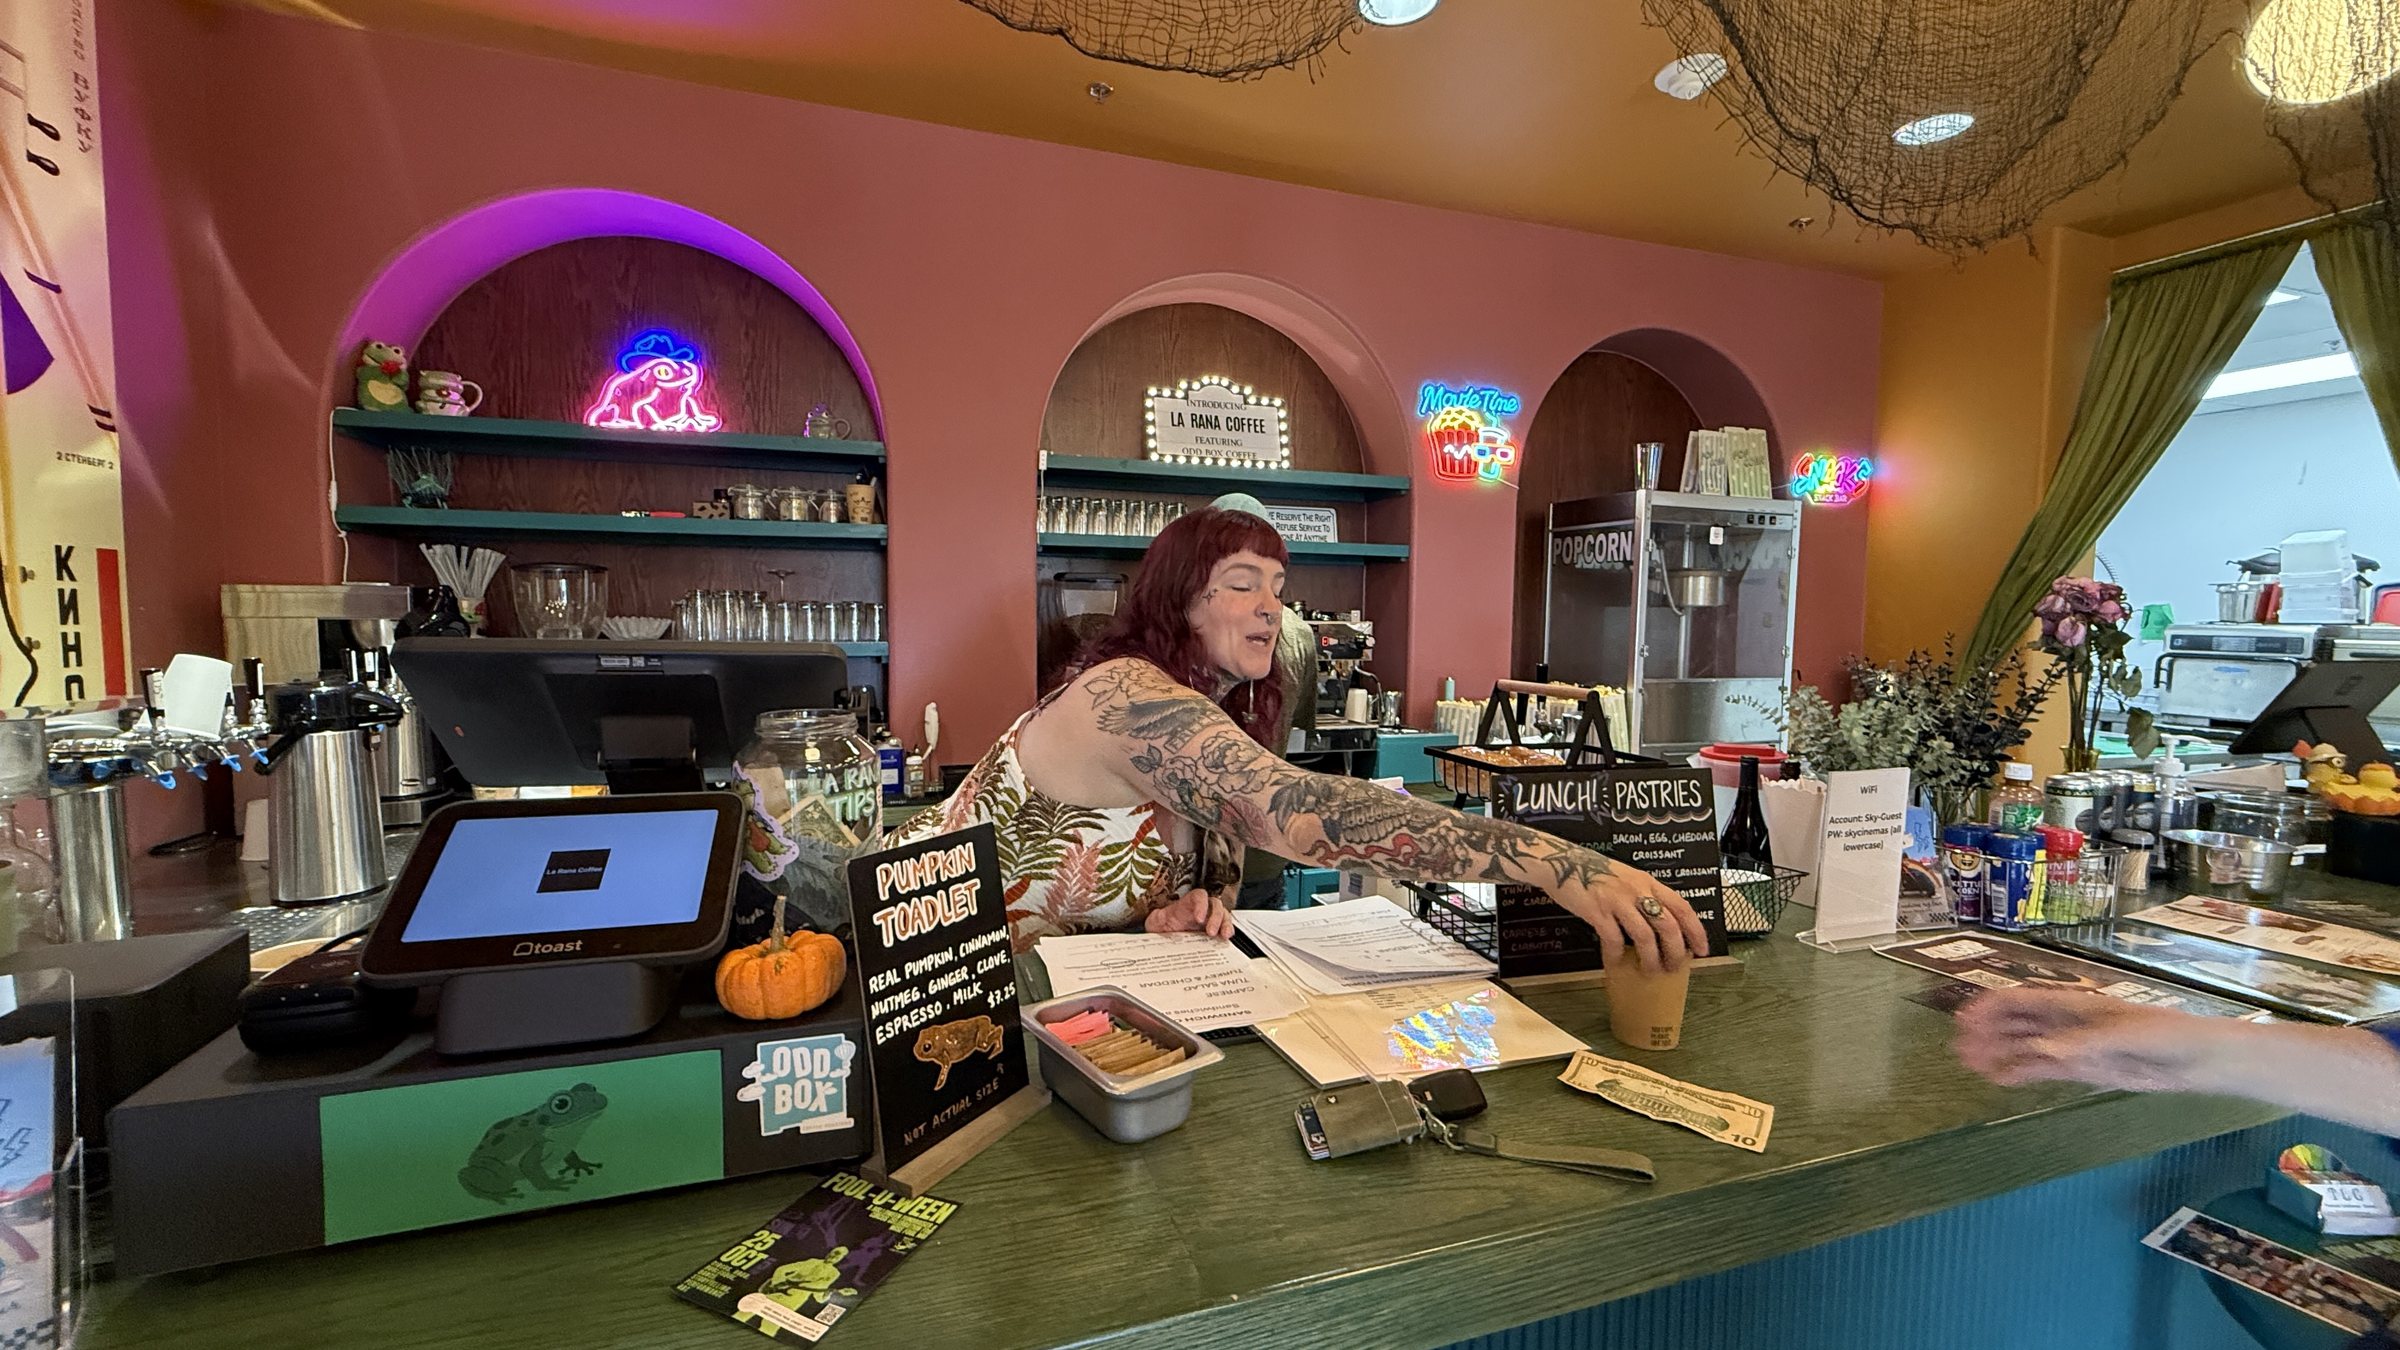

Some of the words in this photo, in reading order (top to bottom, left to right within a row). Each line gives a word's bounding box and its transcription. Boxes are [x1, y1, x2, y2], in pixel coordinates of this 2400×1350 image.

[1186, 399, 1248, 411] INTRODUCING
[1420, 385, 1481, 415] Movie
[1480, 389, 1519, 413] Time
[1170, 411, 1186, 428] LA
[1190, 412, 1221, 431] RANA
[1225, 416, 1266, 434] COFFEE
[1195, 435, 1243, 447] FEATURING
[1181, 446, 1203, 456] ODD
[1205, 448, 1223, 458] BOX
[1225, 449, 1257, 460] COFFEE
[1552, 531, 1633, 565] POPCORN
[844, 763, 880, 791] RAN
[1515, 778, 1599, 813] LUNCH!
[1615, 779, 1702, 811] PASTRIES
[1860, 785, 1878, 794] WiFi
[827, 787, 876, 822] TIPS
[1829, 815, 1863, 825] Account:
[1864, 812, 1903, 823] Sky-Guest
[1612, 833, 1648, 845] BACON,
[1672, 831, 1716, 843] CHEDDAR
[1827, 830, 1843, 839] PW:
[1844, 827, 1888, 838] skycinemas
[1843, 840, 1884, 852] lowercase)
[1632, 848, 1685, 861] CROISSANT
[557, 866, 577, 875] Rana
[577, 866, 603, 874] Coffee
[876, 842, 976, 901] PUMPKIN
[1675, 867, 1719, 877] CROISSANT
[1675, 887, 1717, 898] OISSANT
[1957, 886, 1980, 895] CORN
[873, 878, 981, 948] TOADLET
[533, 940, 583, 955] toast
[868, 968, 901, 995] REAL
[904, 946, 958, 980] PUMPKIN,
[959, 925, 1010, 958] CINNAMON,
[1193, 973, 1203, 982] &
[1203, 968, 1244, 980] TURKEY
[870, 986, 926, 1020] NUTMEG,
[976, 949, 1011, 975] CLOVE,
[1139, 976, 1192, 989] CHEDDAR
[1183, 980, 1219, 992] SALAD
[1218, 977, 1249, 988] TUNA
[952, 981, 984, 1006] MILK
[987, 981, 1016, 1009] $7.25
[1205, 986, 1256, 998] CAPRESE
[1174, 1003, 1240, 1016] Sandwiches
[1184, 1009, 1253, 1022] SANDWICH
[773, 1046, 831, 1079] ODD
[774, 1078, 835, 1116] BOX
[903, 1121, 927, 1146] NOT
[932, 1095, 973, 1129] ACTUAL
[975, 1077, 999, 1101] SIZE
[1731, 1133, 1758, 1148] 10
[821, 1171, 959, 1226] FOOL-U-WEEN
[741, 1229, 783, 1252] 25
[719, 1245, 769, 1271] OCT
